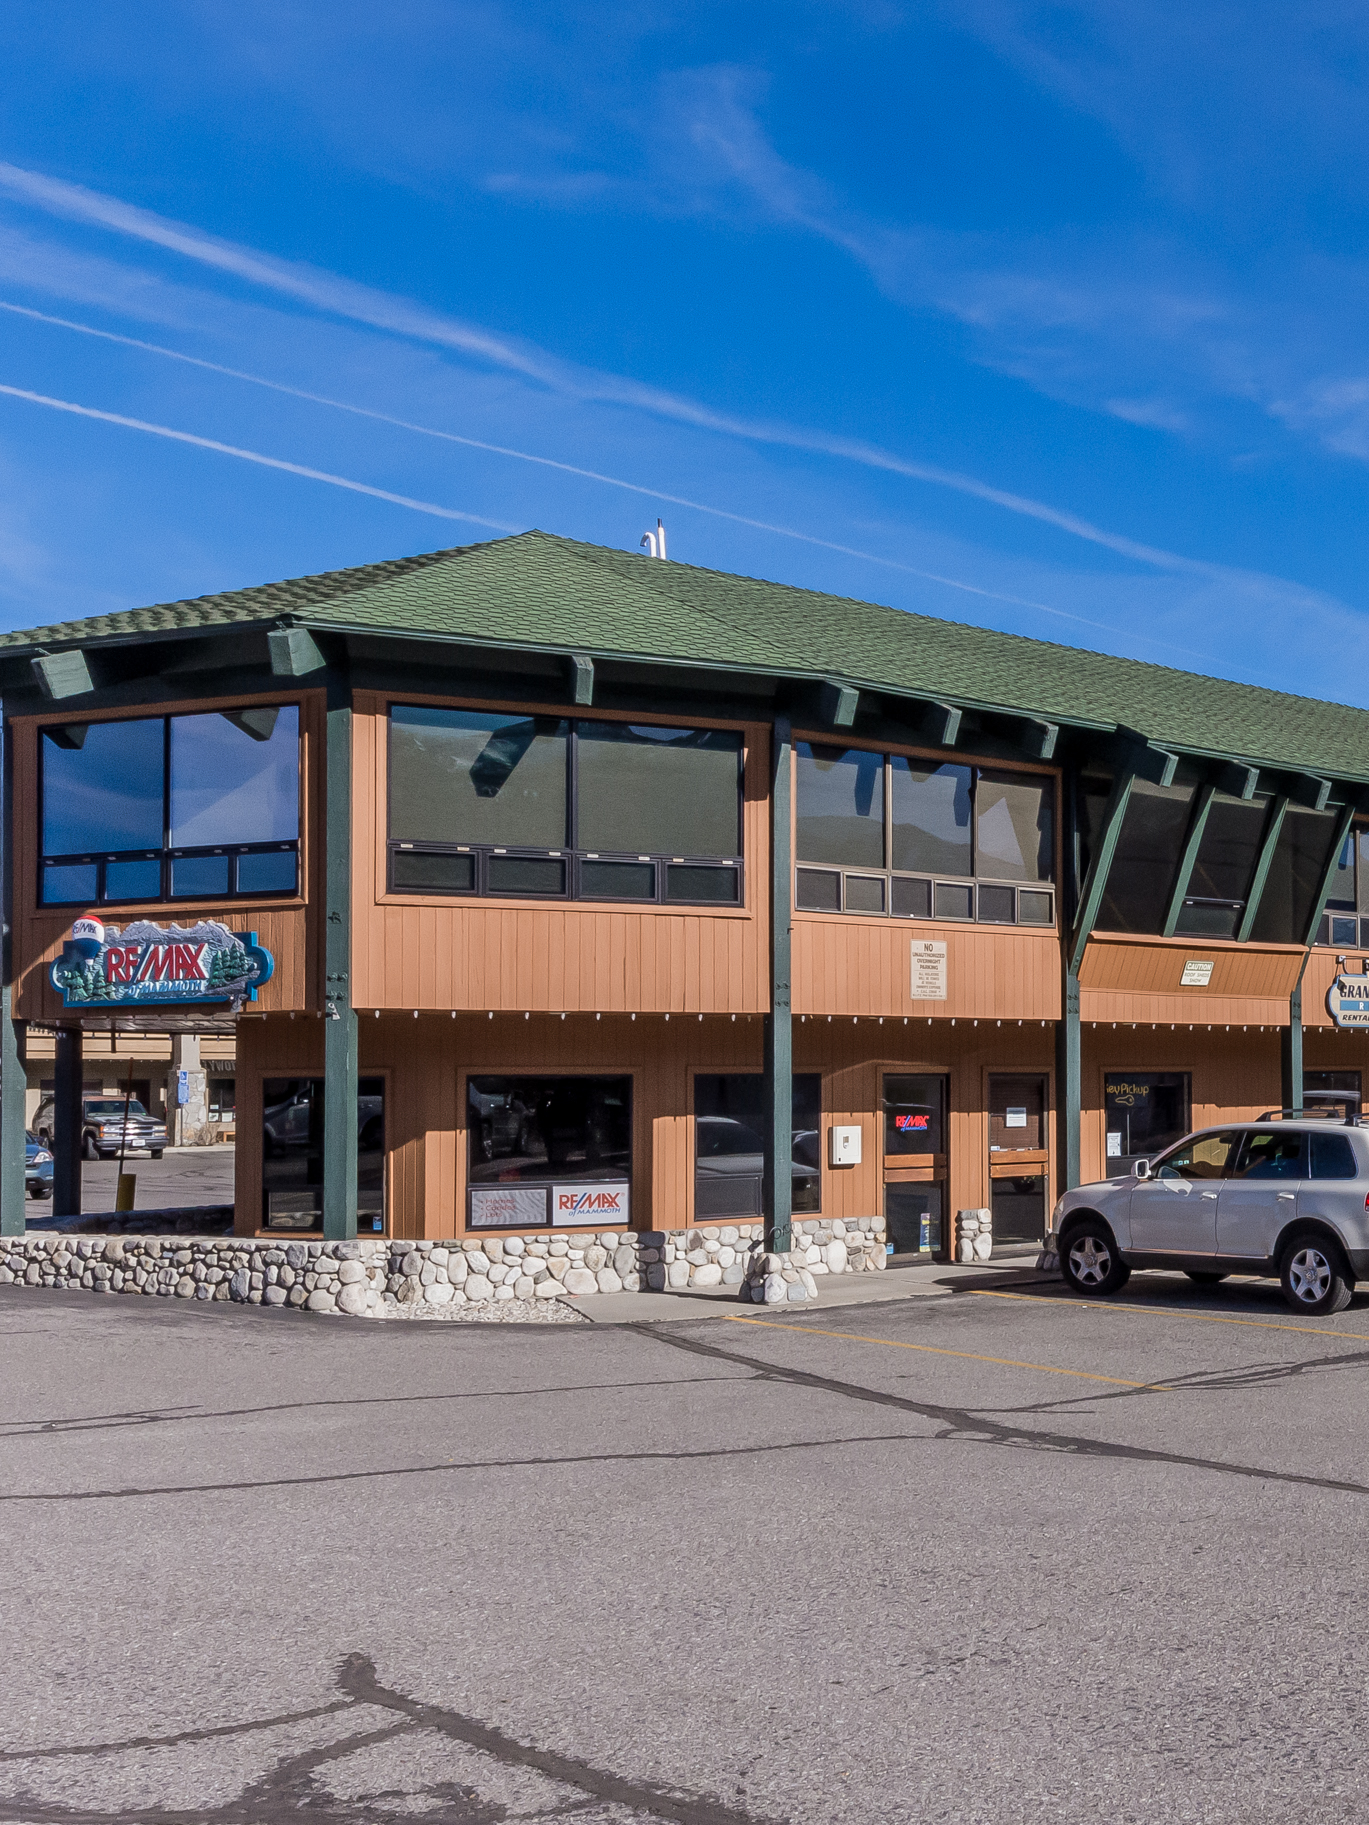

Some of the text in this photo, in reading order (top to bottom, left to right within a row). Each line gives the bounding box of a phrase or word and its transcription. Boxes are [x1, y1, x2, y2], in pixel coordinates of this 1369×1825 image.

[923, 943, 933, 952] NO
[107, 942, 207, 983] RE/MAX
[1121, 1083, 1149, 1097] Pickup
[896, 1115, 928, 1127] RE/MAX
[559, 1192, 620, 1210] RE/MAX
[568, 1208, 577, 1217] of
